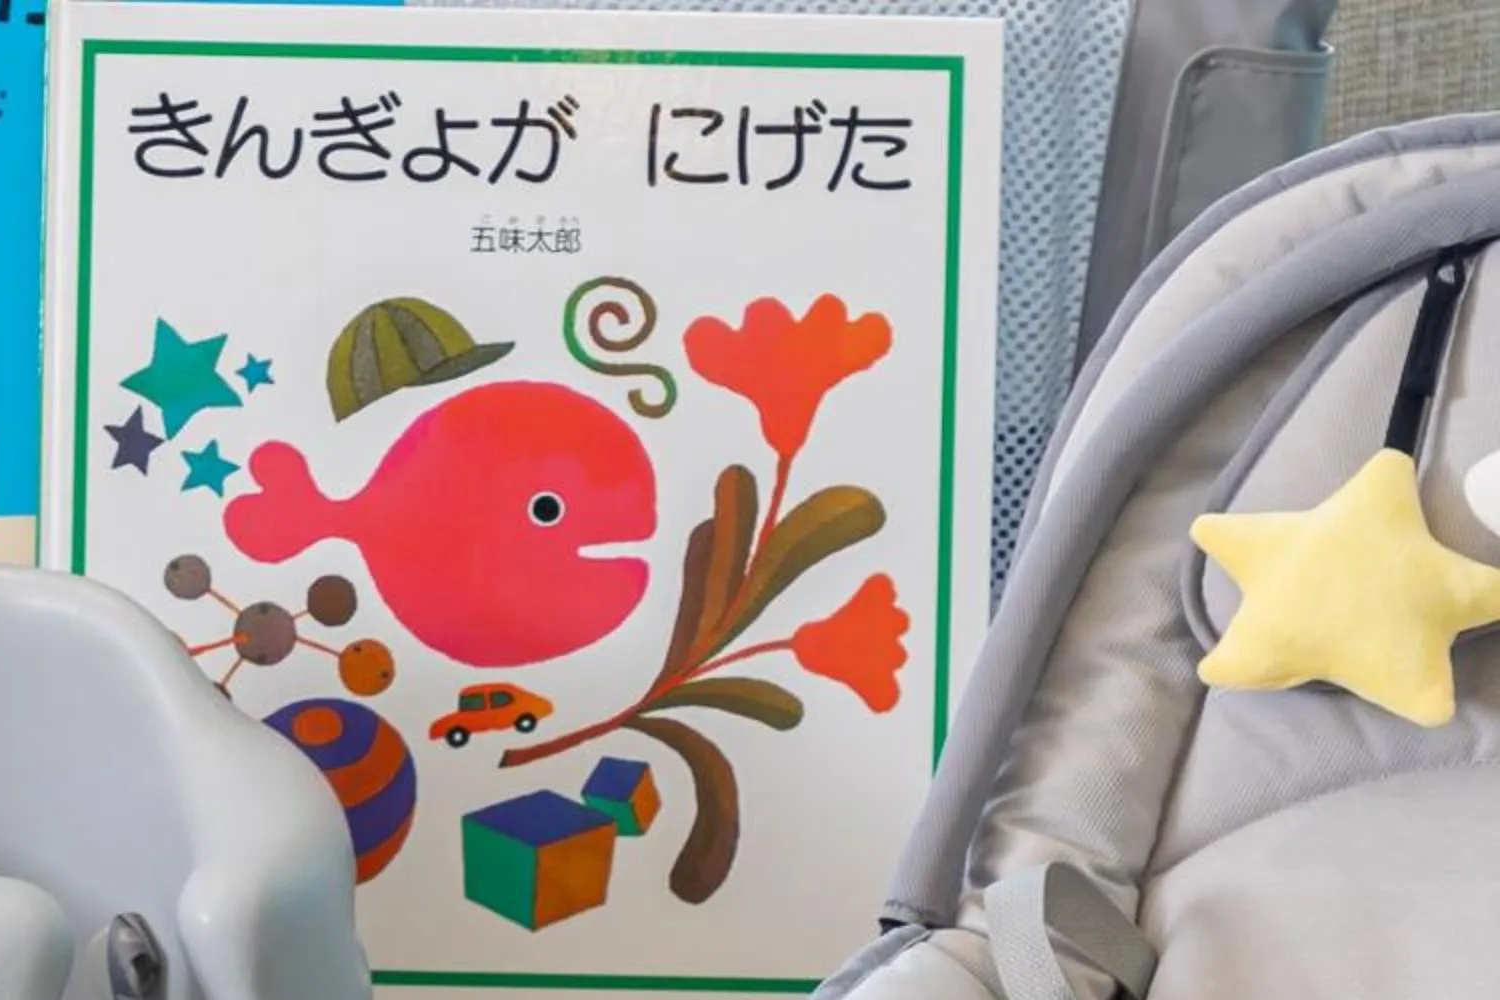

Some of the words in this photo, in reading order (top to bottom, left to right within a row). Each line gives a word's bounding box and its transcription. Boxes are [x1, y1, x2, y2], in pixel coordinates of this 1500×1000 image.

[126, 90, 581, 186] きんぎょが
[646, 98, 914, 193] にげた
[470, 226, 582, 254] 五味太郎
